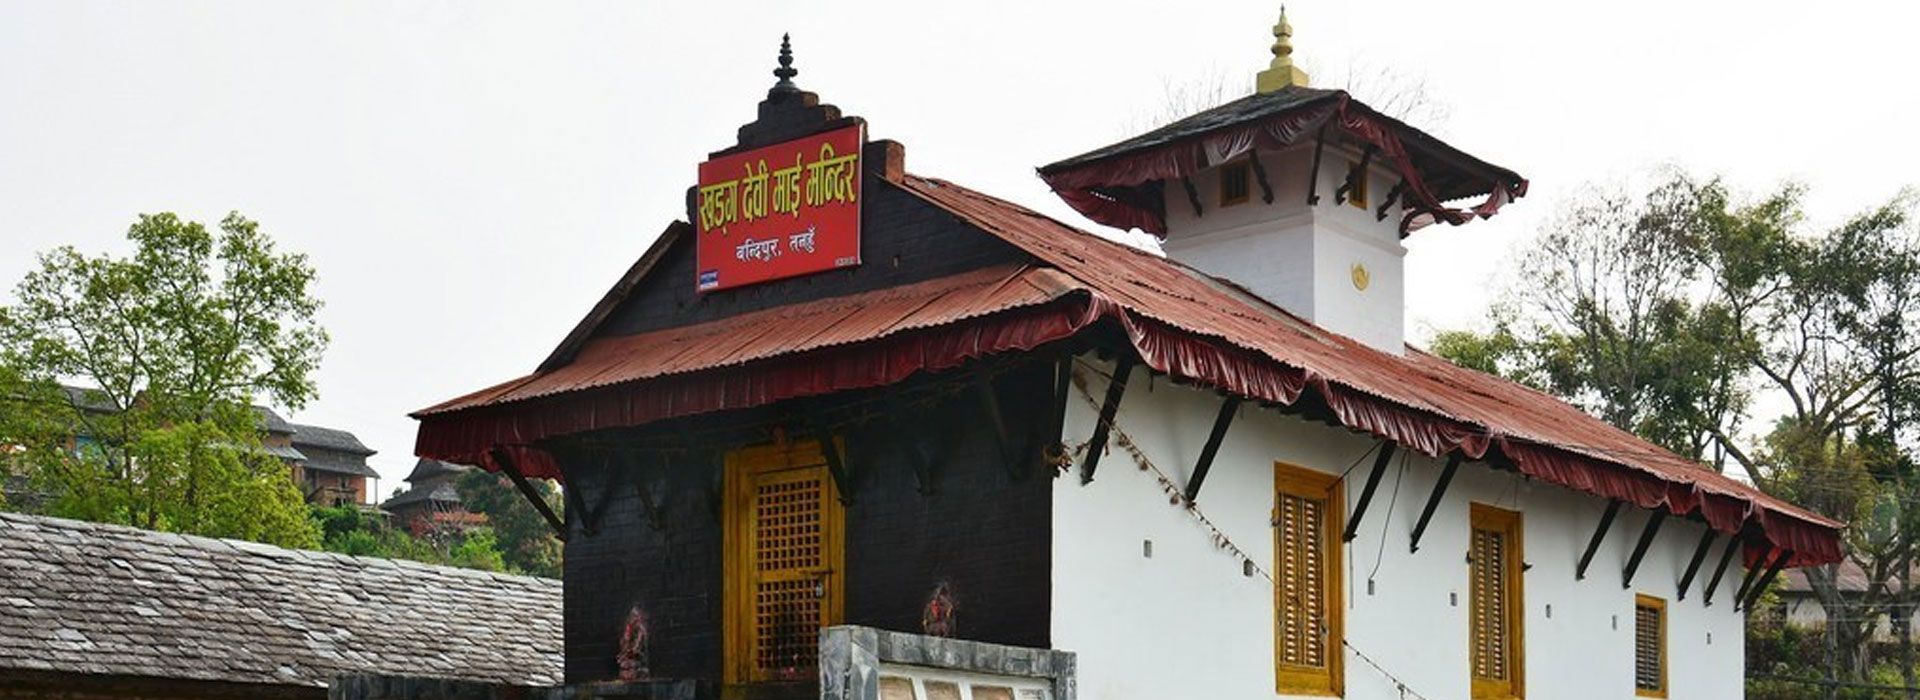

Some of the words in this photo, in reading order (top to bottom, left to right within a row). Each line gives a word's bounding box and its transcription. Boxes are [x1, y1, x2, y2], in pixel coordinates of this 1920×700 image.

[742, 160, 768, 223] देवी
[772, 153, 802, 218] माई
[806, 143, 858, 204] मन्दिर
